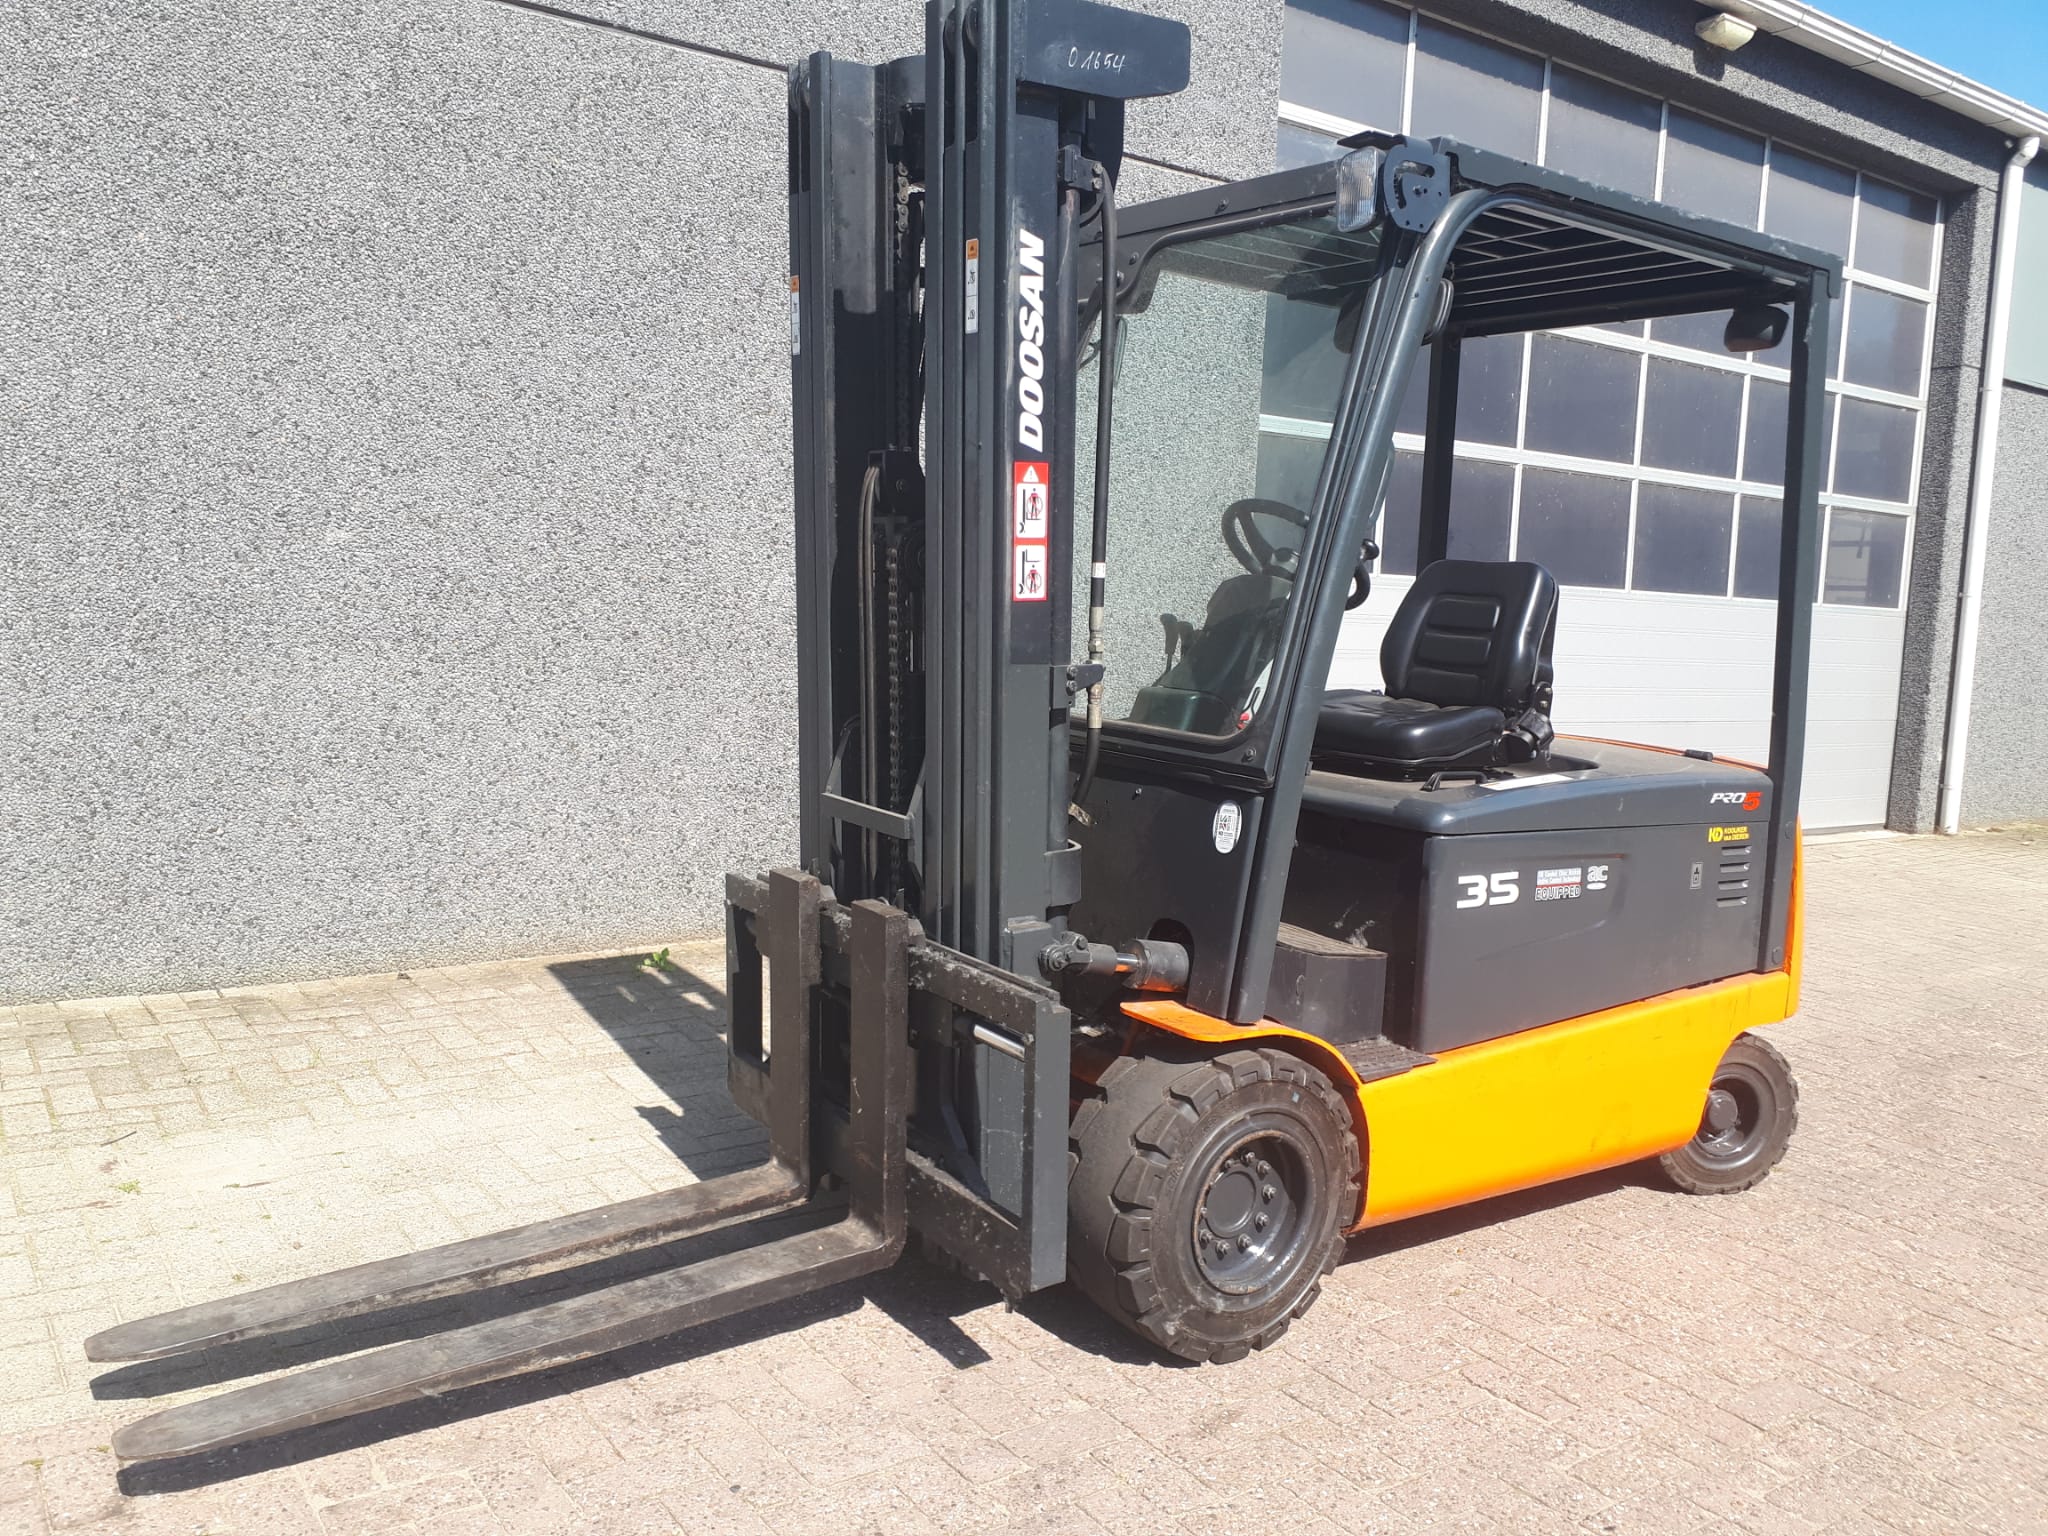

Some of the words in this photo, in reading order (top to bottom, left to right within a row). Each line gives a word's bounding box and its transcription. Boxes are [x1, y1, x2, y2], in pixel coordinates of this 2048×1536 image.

[1019, 228, 1045, 453] DOOSAN
[1456, 871, 1519, 909] 35
[1535, 884, 1581, 901] EQUIPPED
